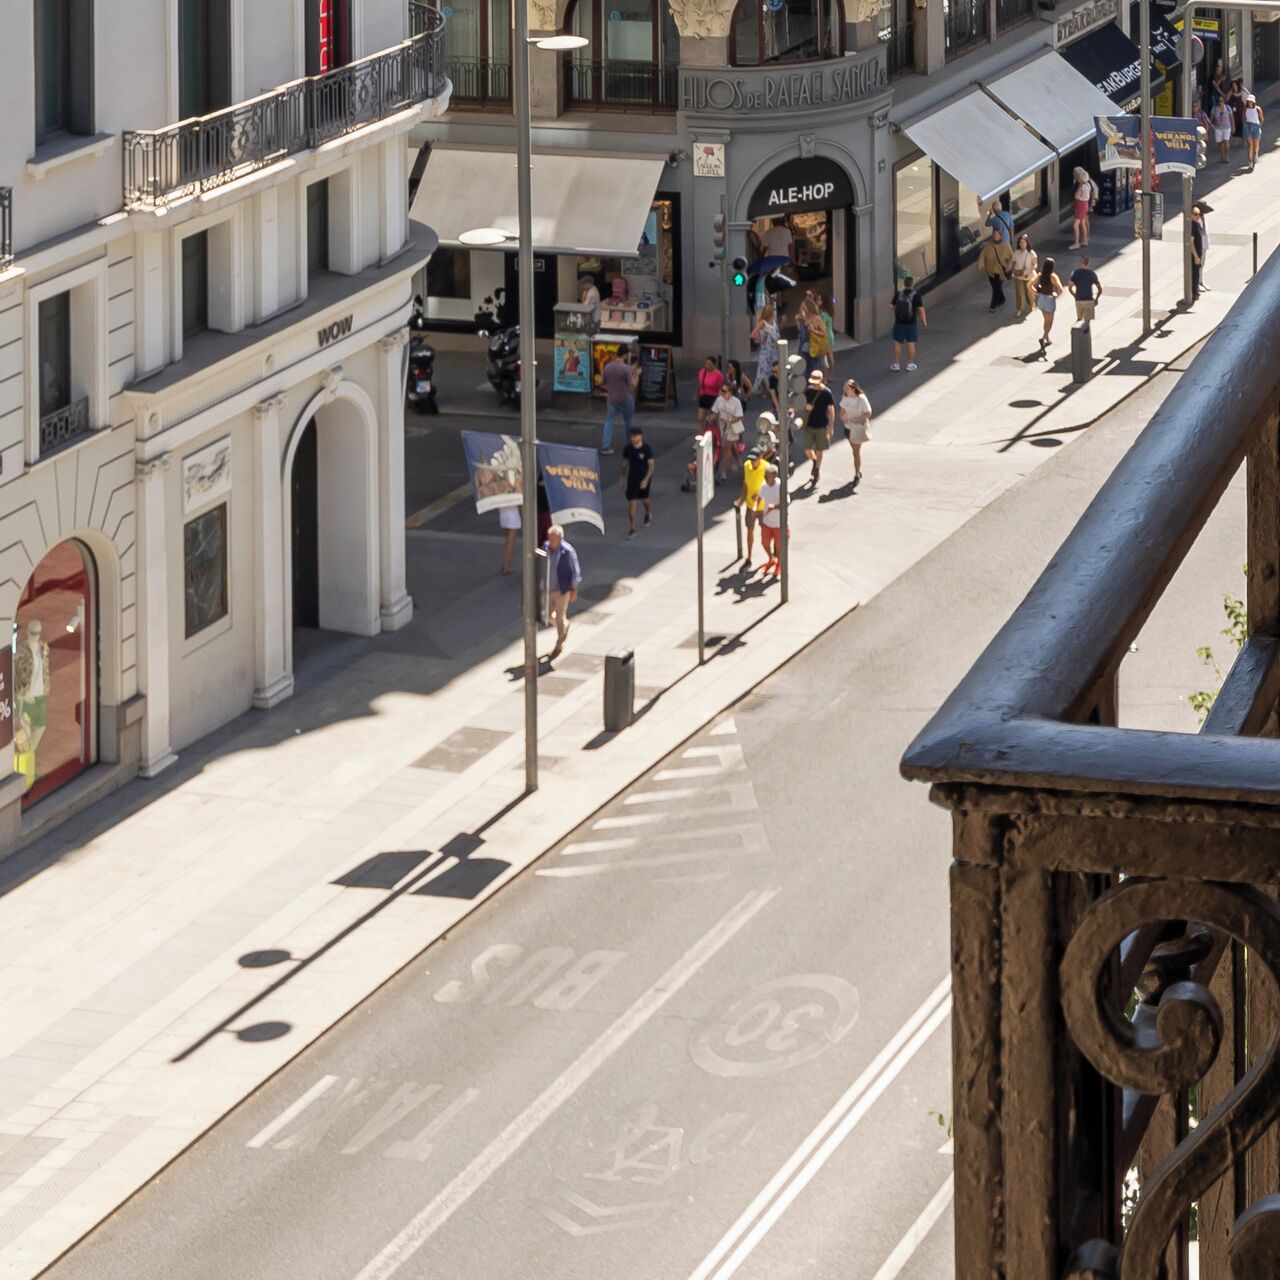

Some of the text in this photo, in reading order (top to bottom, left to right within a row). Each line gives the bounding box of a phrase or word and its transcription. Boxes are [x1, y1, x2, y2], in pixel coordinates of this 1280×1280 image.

[681, 76, 744, 110] HIJOS
[746, 93, 762, 108] DE
[765, 71, 831, 109] RAFAEL
[1164, 140, 1191, 150] VILLA
[768, 182, 834, 206] ALE-HOP
[317, 313, 354, 347] WOW
[433, 943, 629, 1011] BUS
[725, 999, 825, 1051] 30
